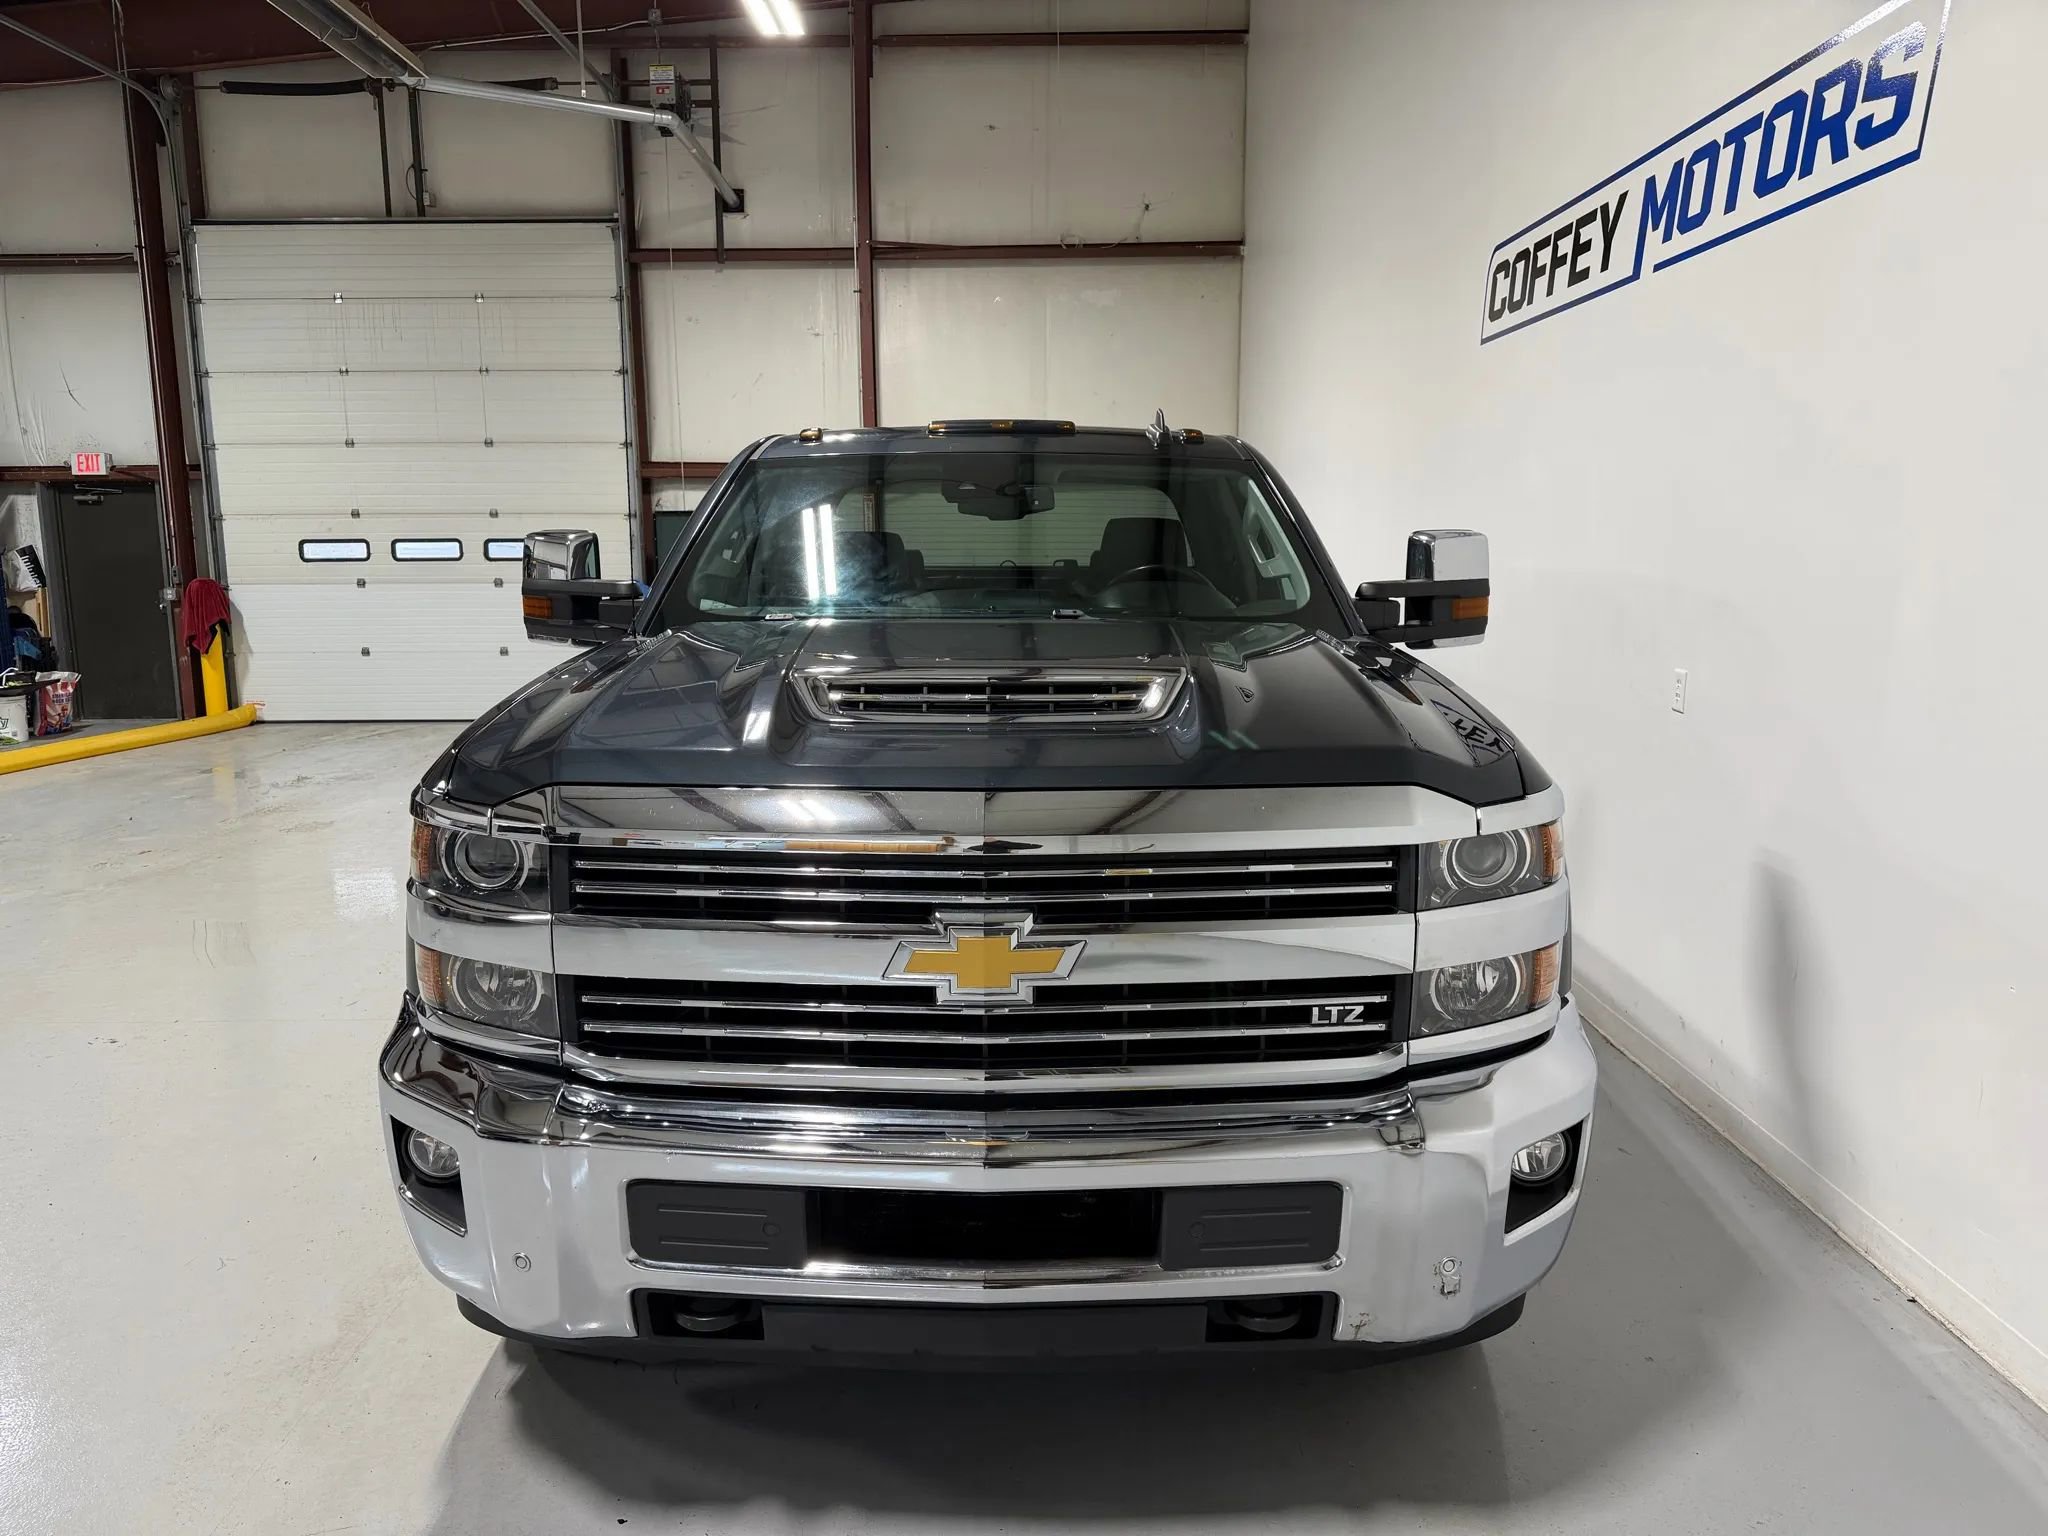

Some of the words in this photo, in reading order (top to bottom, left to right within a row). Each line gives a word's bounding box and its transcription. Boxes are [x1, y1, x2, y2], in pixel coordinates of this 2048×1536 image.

[1488, 189, 1629, 324] COFFEY
[1638, 20, 1927, 246] MOTORS
[76, 453, 101, 473] EXIT
[1311, 1005, 1364, 1025] LTZ
